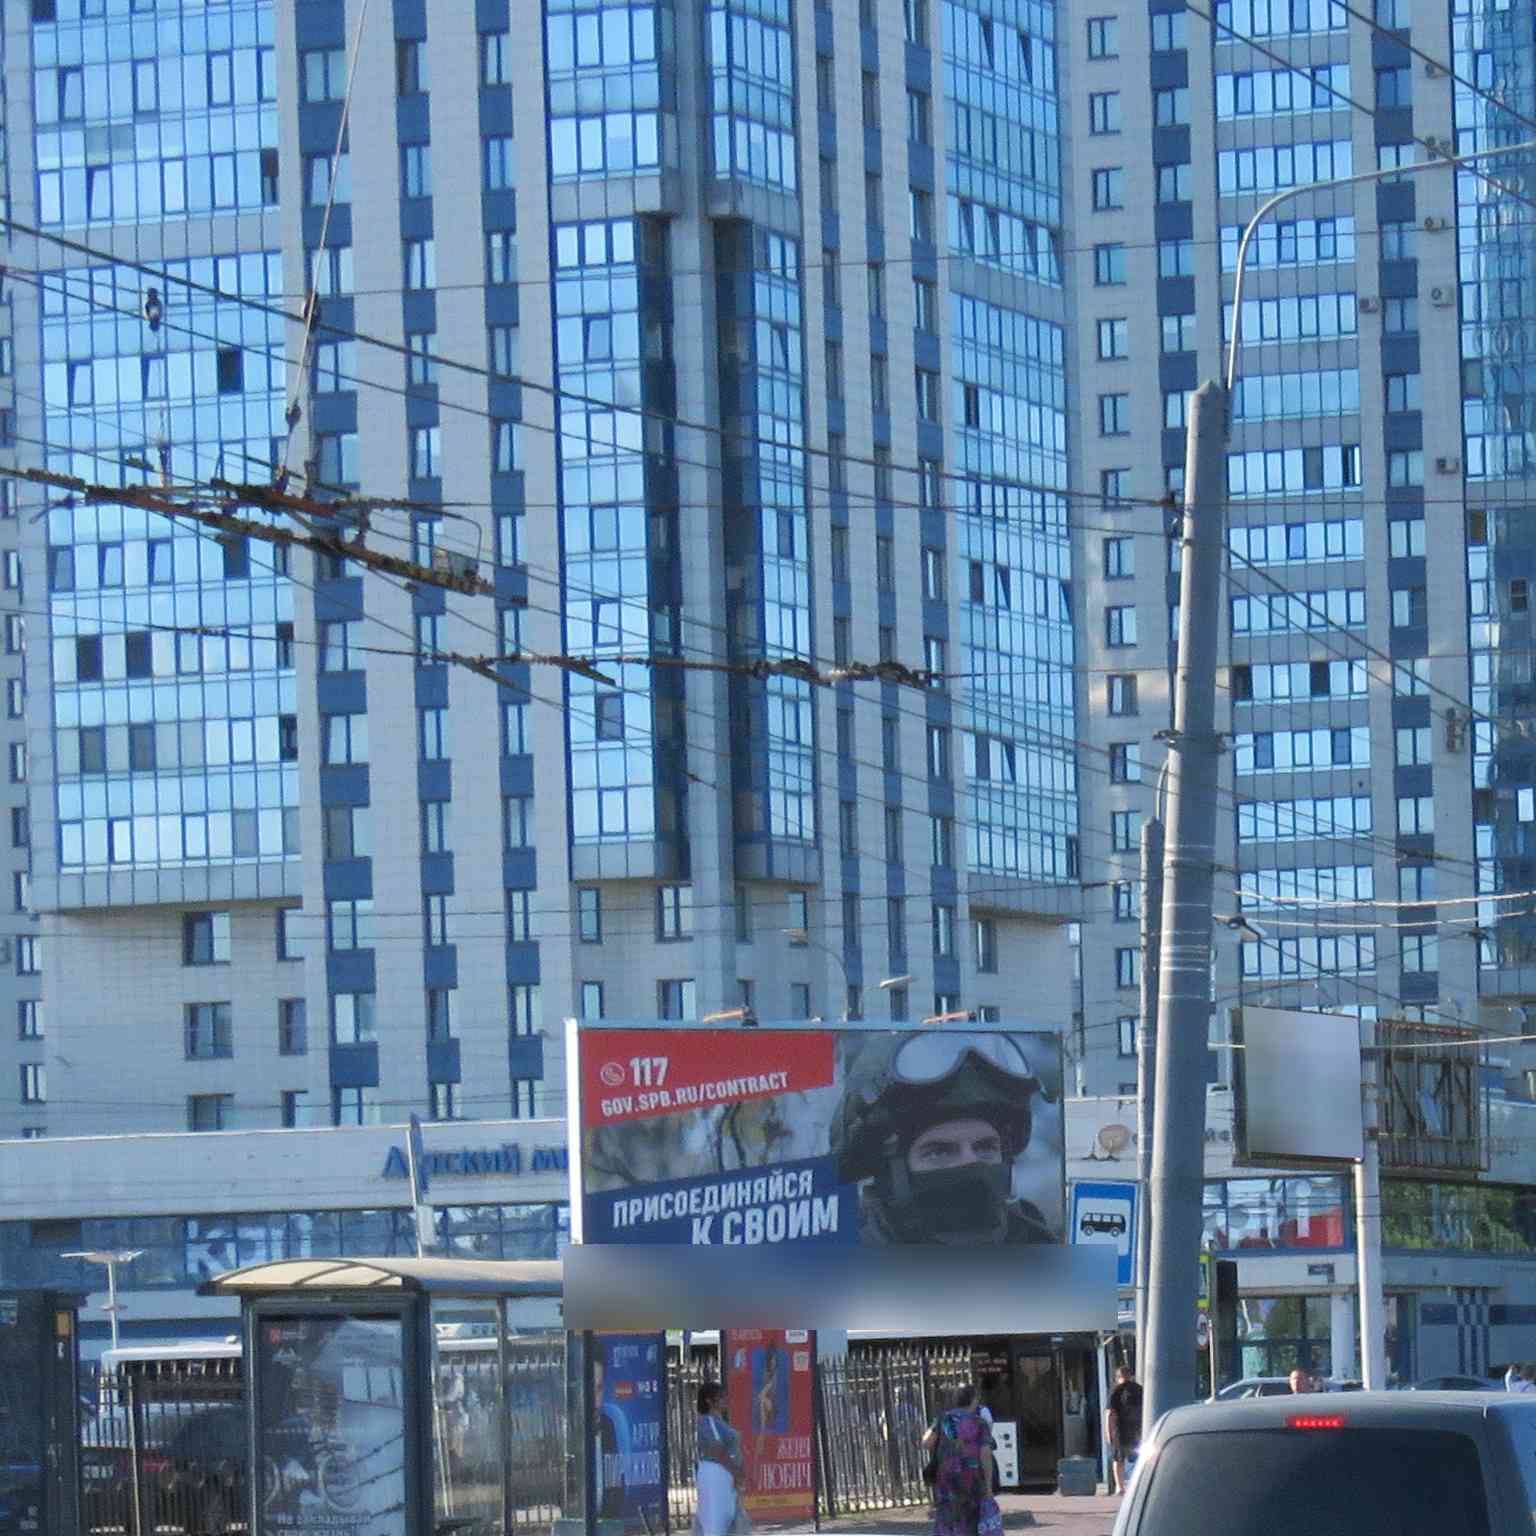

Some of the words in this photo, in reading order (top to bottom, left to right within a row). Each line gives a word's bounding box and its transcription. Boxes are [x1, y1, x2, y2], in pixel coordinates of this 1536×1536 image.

[601, 1072, 788, 1117] GOV.SPB.RU/CONTRACT
[630, 1056, 668, 1088] 117
[613, 1168, 815, 1228] ПРИСОЕДИНЯЙСЯ
[692, 1216, 714, 1244] К
[722, 1195, 840, 1244] СВОИМ
